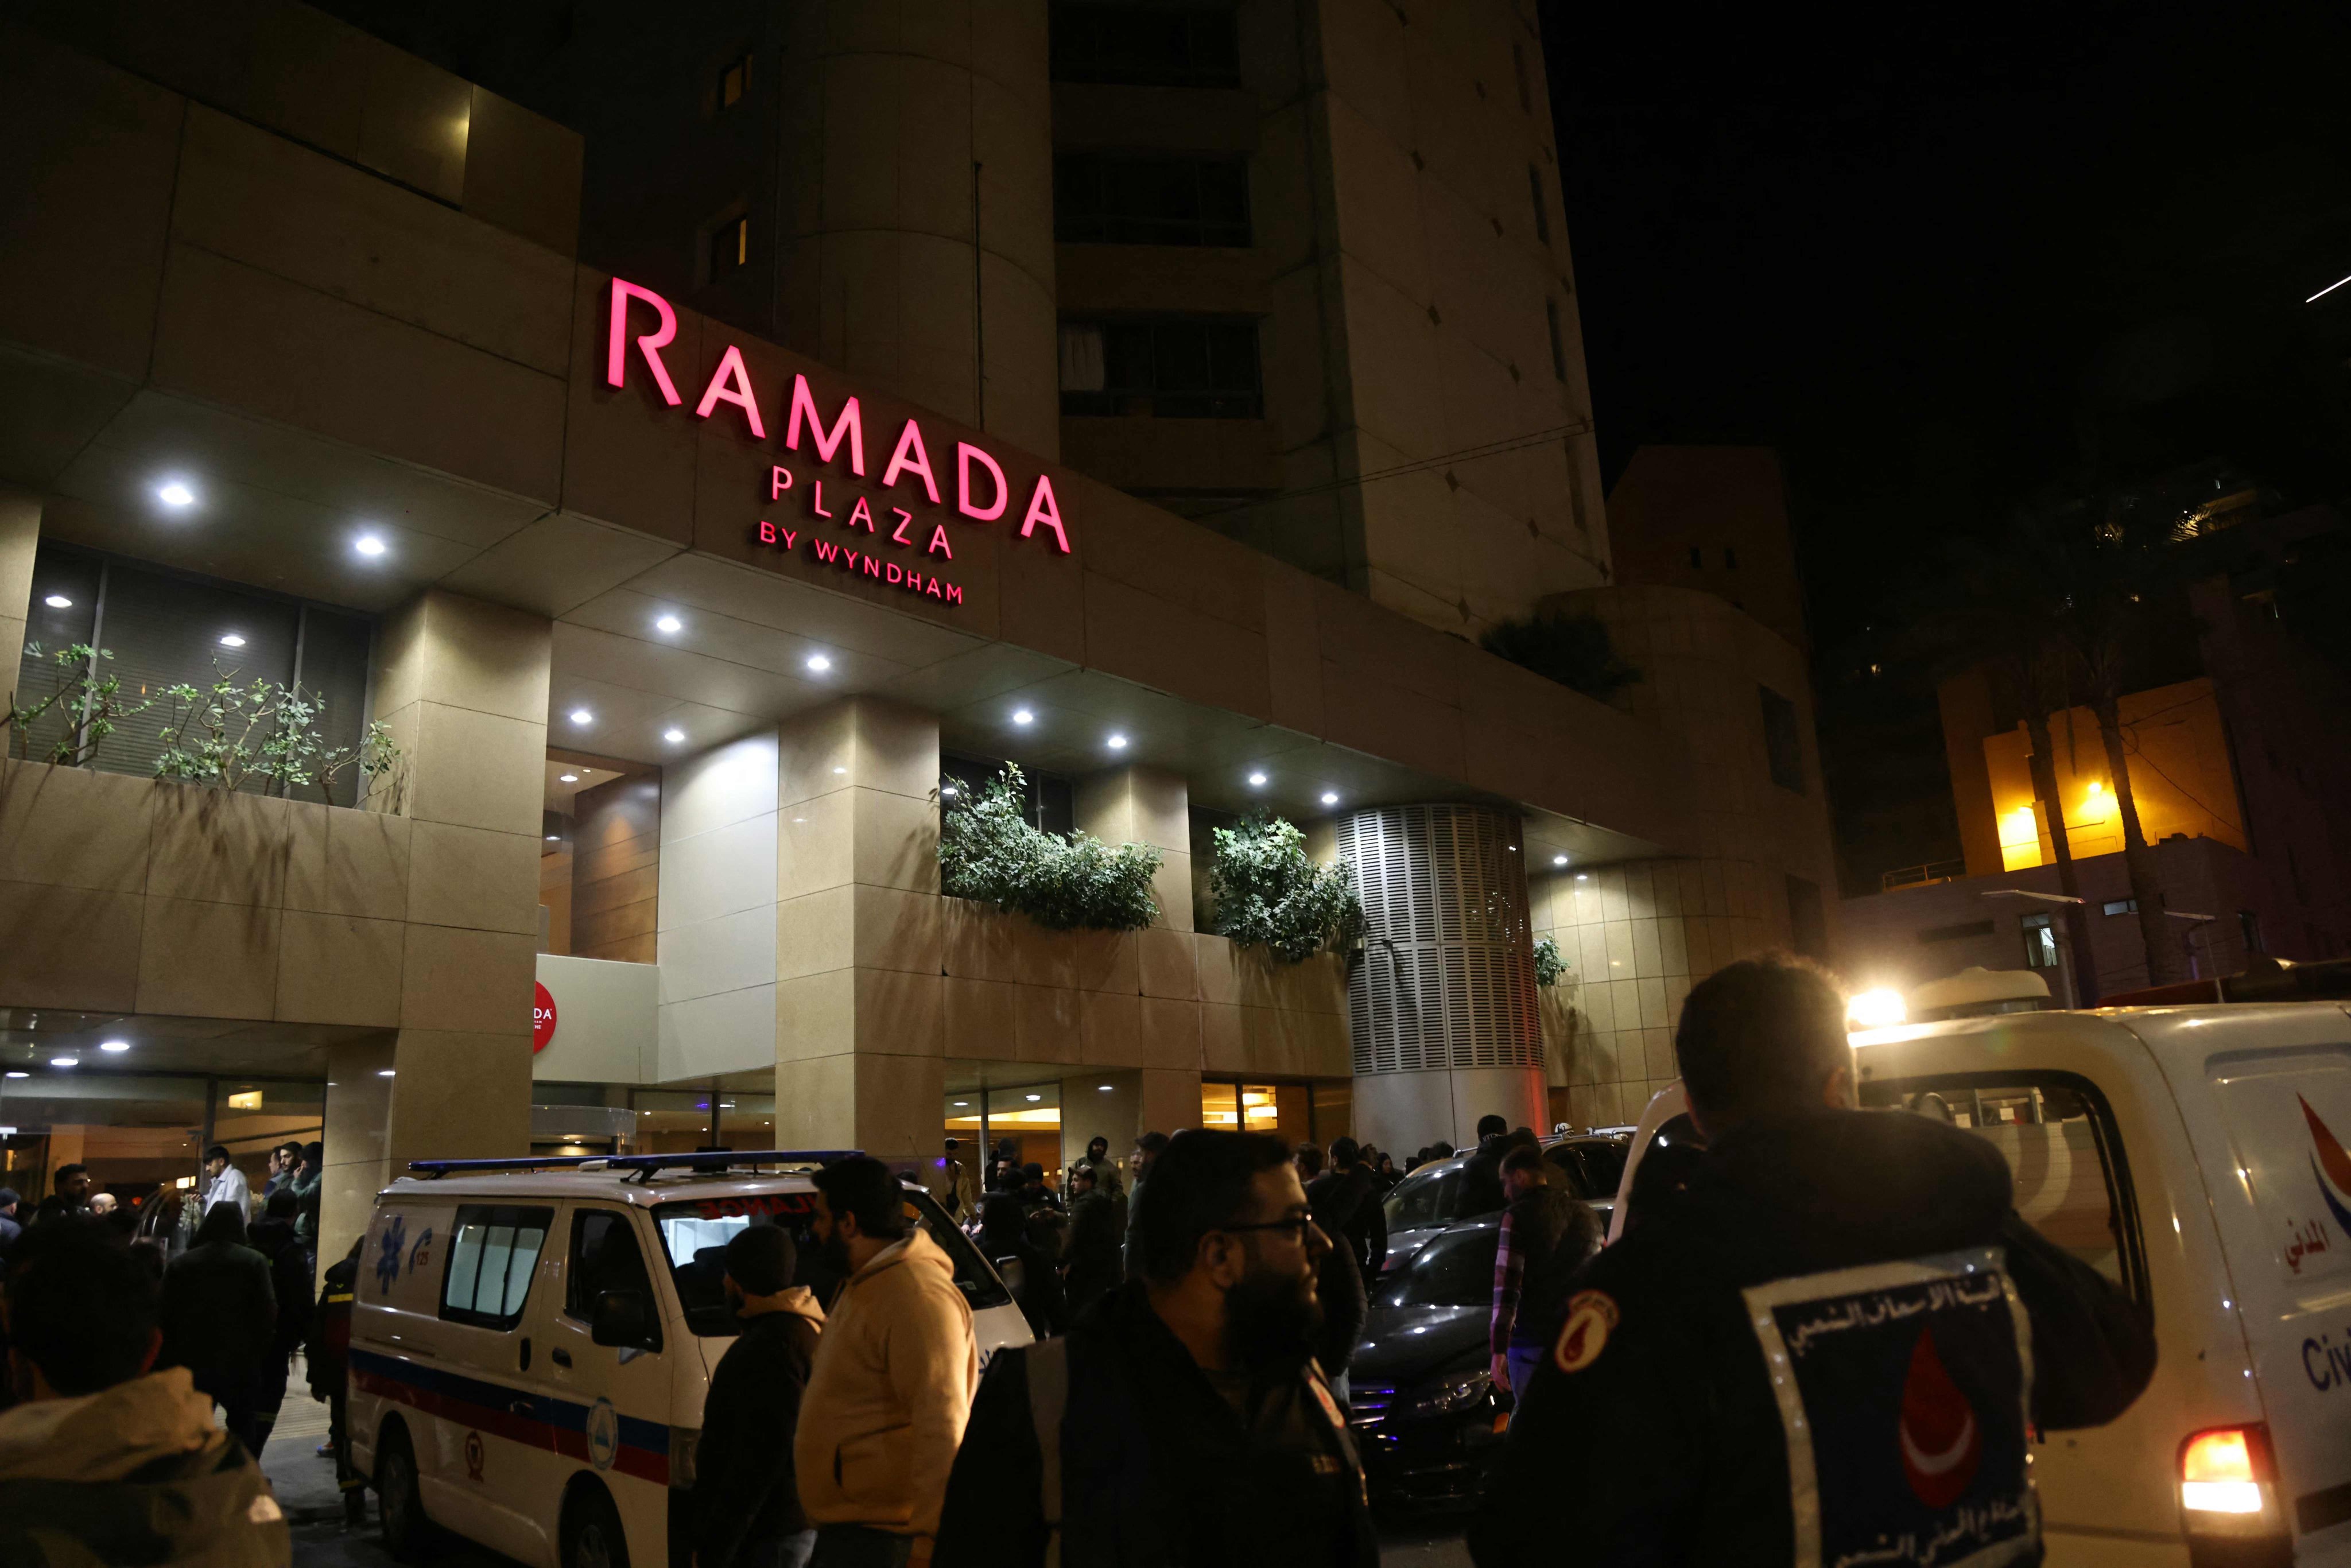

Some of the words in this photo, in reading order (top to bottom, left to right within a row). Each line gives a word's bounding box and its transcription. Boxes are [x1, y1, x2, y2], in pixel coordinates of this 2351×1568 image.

[607, 277, 1070, 554] RAMADA
[772, 465, 952, 559] PLAZA
[759, 521, 797, 550] BY
[814, 538, 963, 604] WYNDHAM
[2302, 1327, 2351, 1391] Civ
